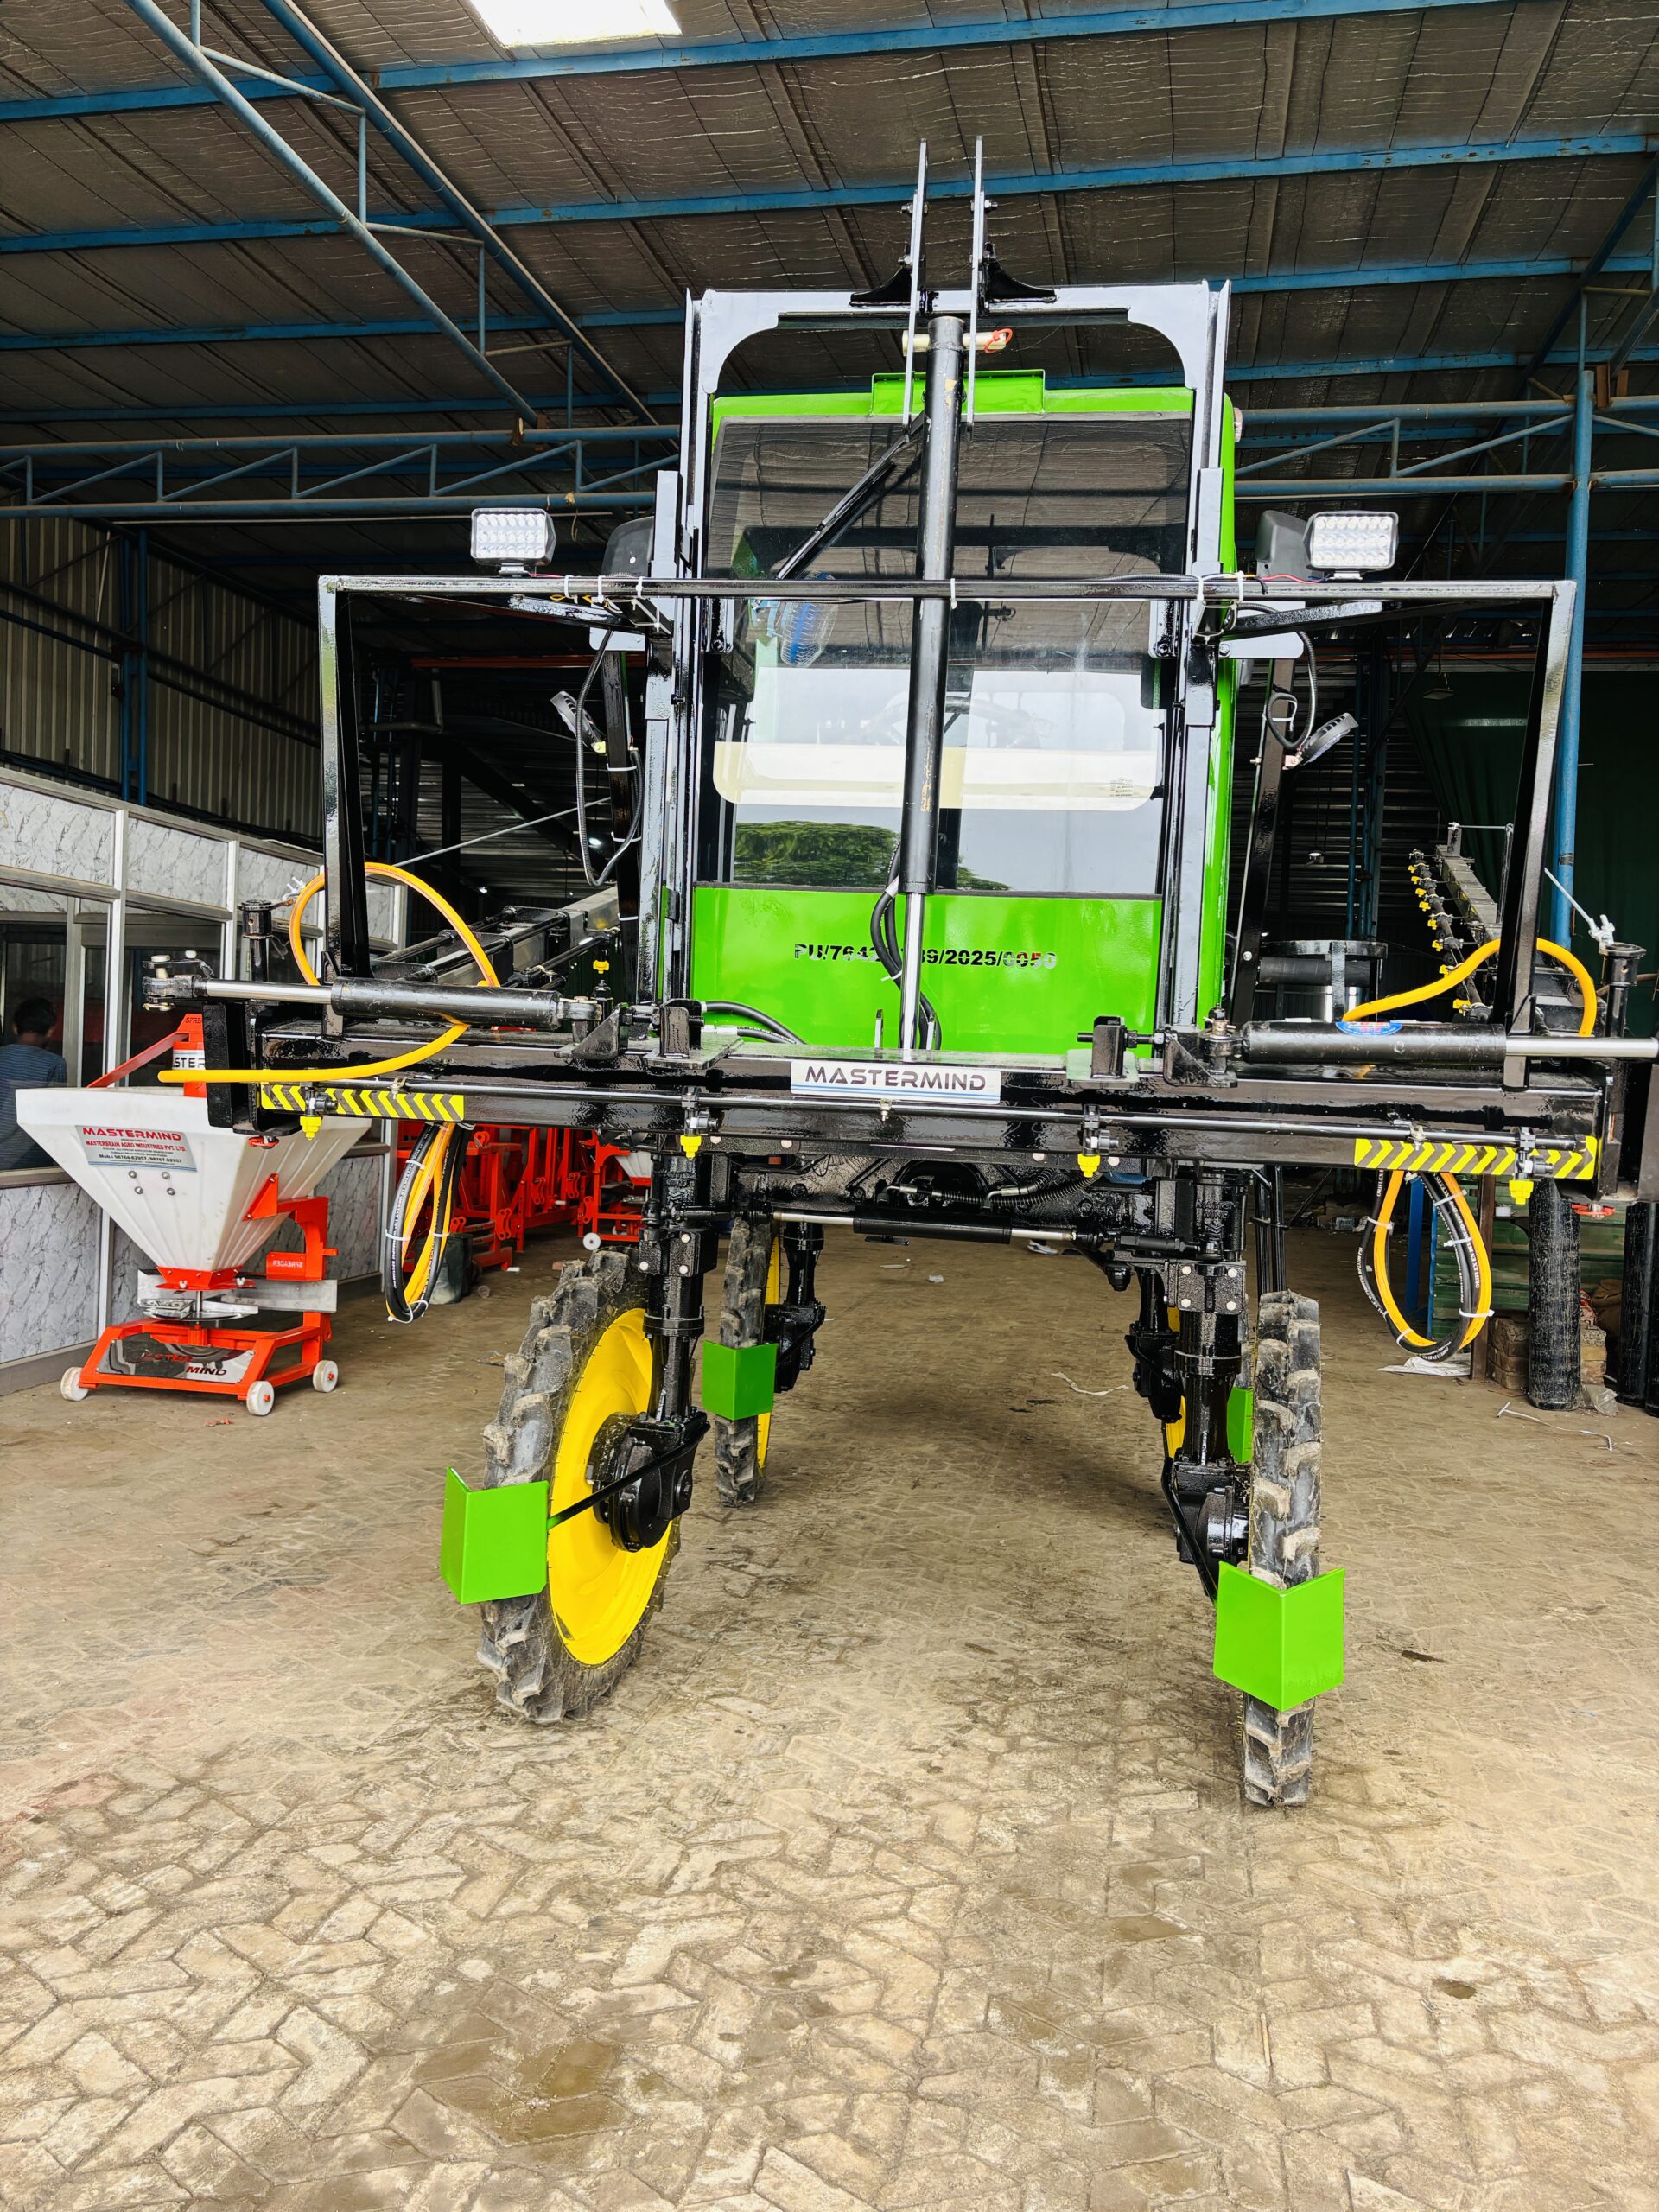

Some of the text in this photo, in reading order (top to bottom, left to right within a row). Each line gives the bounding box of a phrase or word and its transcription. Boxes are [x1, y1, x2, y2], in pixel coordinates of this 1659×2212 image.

[805, 1065, 986, 1092] MASTERMIND
[82, 1127, 182, 1141] MASTERMIND
[186, 1366, 227, 1376] MIND
